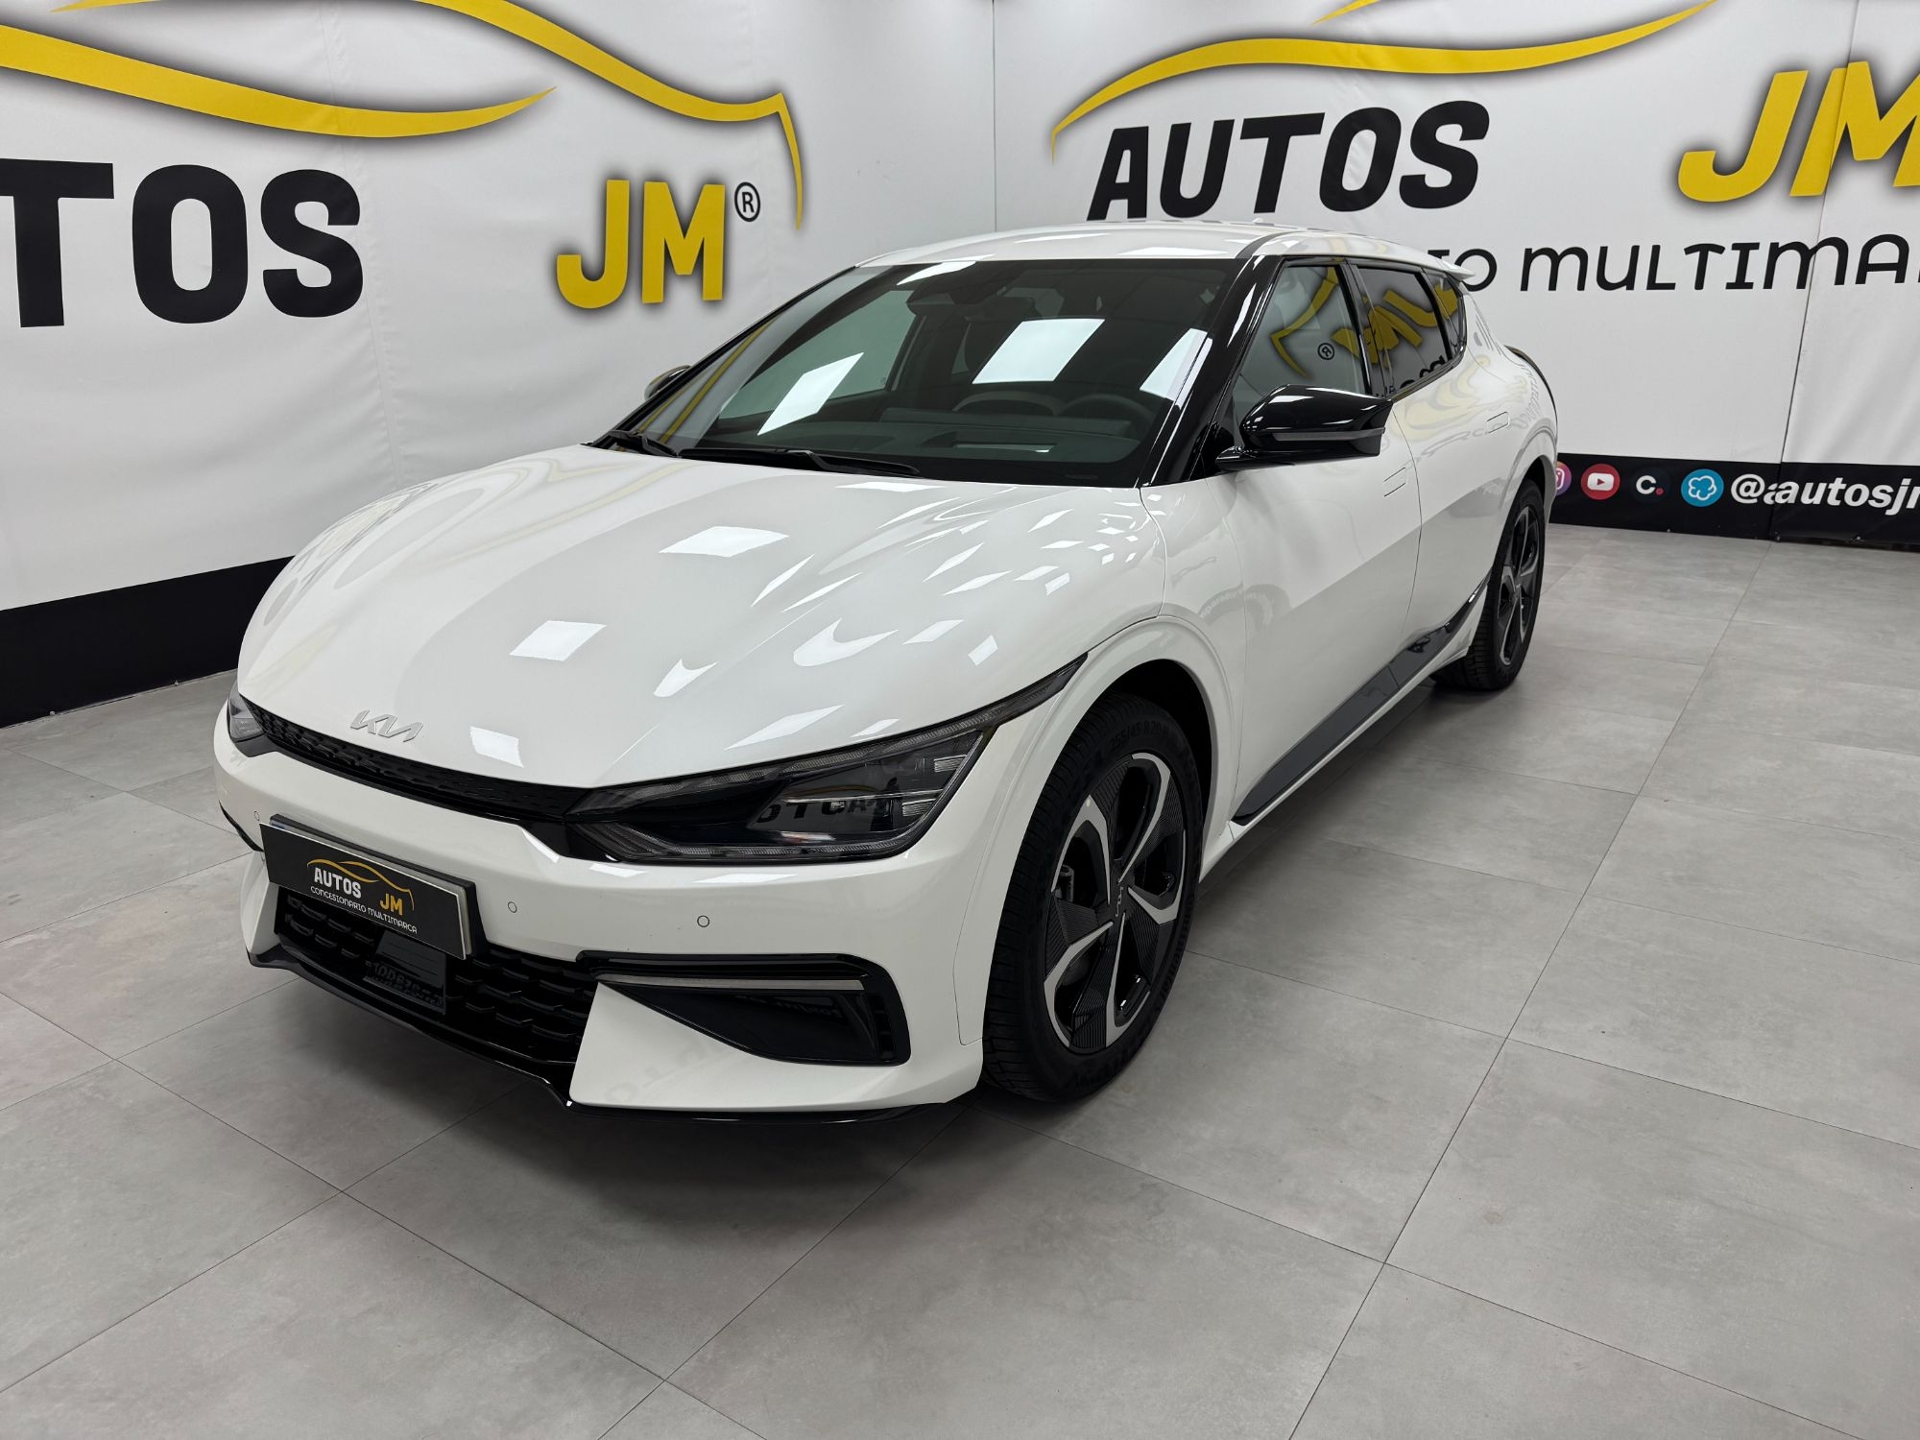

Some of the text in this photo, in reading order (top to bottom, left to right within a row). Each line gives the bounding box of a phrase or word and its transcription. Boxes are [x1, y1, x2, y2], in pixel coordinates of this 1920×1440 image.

[1086, 99, 1490, 222] AUTOS
[1520, 234, 1920, 293] MULTIMA
[350, 709, 424, 742] KIA
[313, 867, 362, 899] AUTOS
[379, 892, 403, 916] JM
